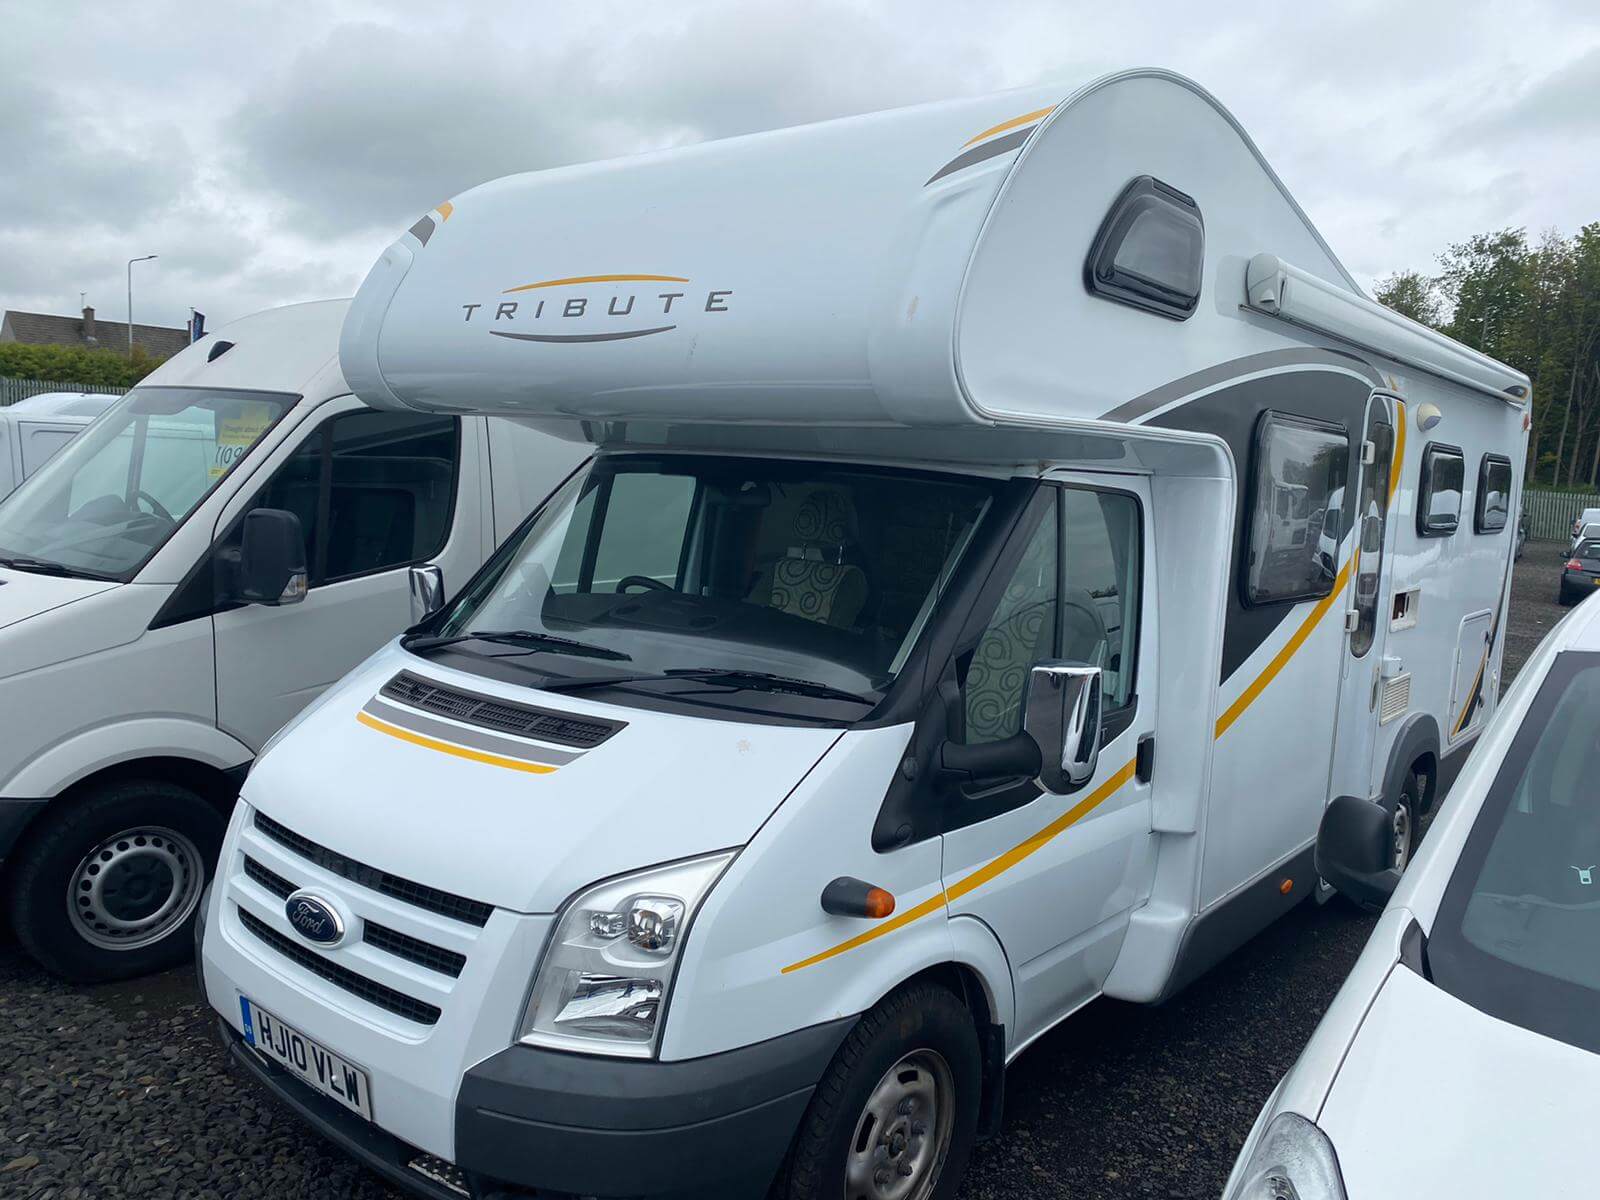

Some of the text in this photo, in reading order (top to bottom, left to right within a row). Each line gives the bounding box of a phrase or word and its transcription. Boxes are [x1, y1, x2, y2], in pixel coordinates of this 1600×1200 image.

[462, 290, 733, 322] TRIBUTE
[292, 901, 326, 935] Ford
[257, 1011, 361, 1108] HJ10 VLW
